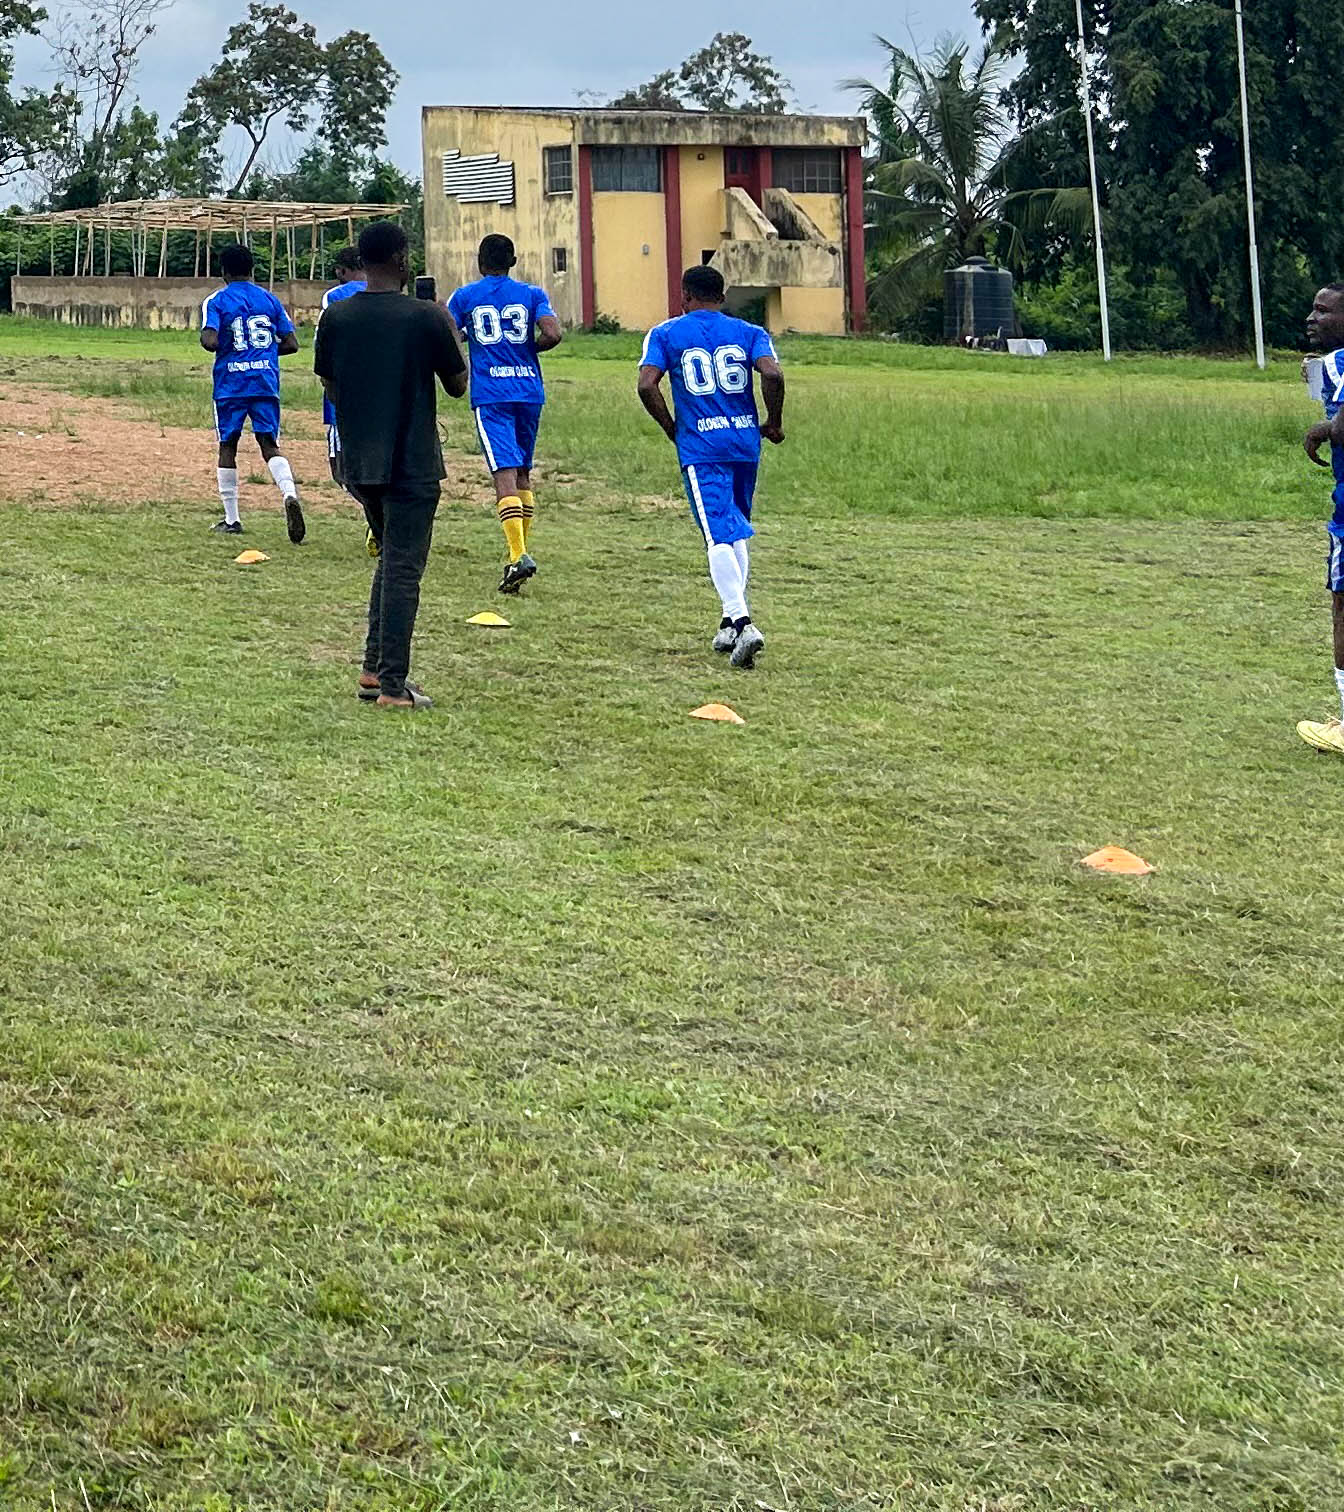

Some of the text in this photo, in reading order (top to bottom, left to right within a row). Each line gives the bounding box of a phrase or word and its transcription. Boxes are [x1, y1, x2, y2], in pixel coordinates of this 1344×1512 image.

[231, 315, 273, 351] 16
[472, 304, 529, 345] 03
[681, 344, 748, 396] 06
